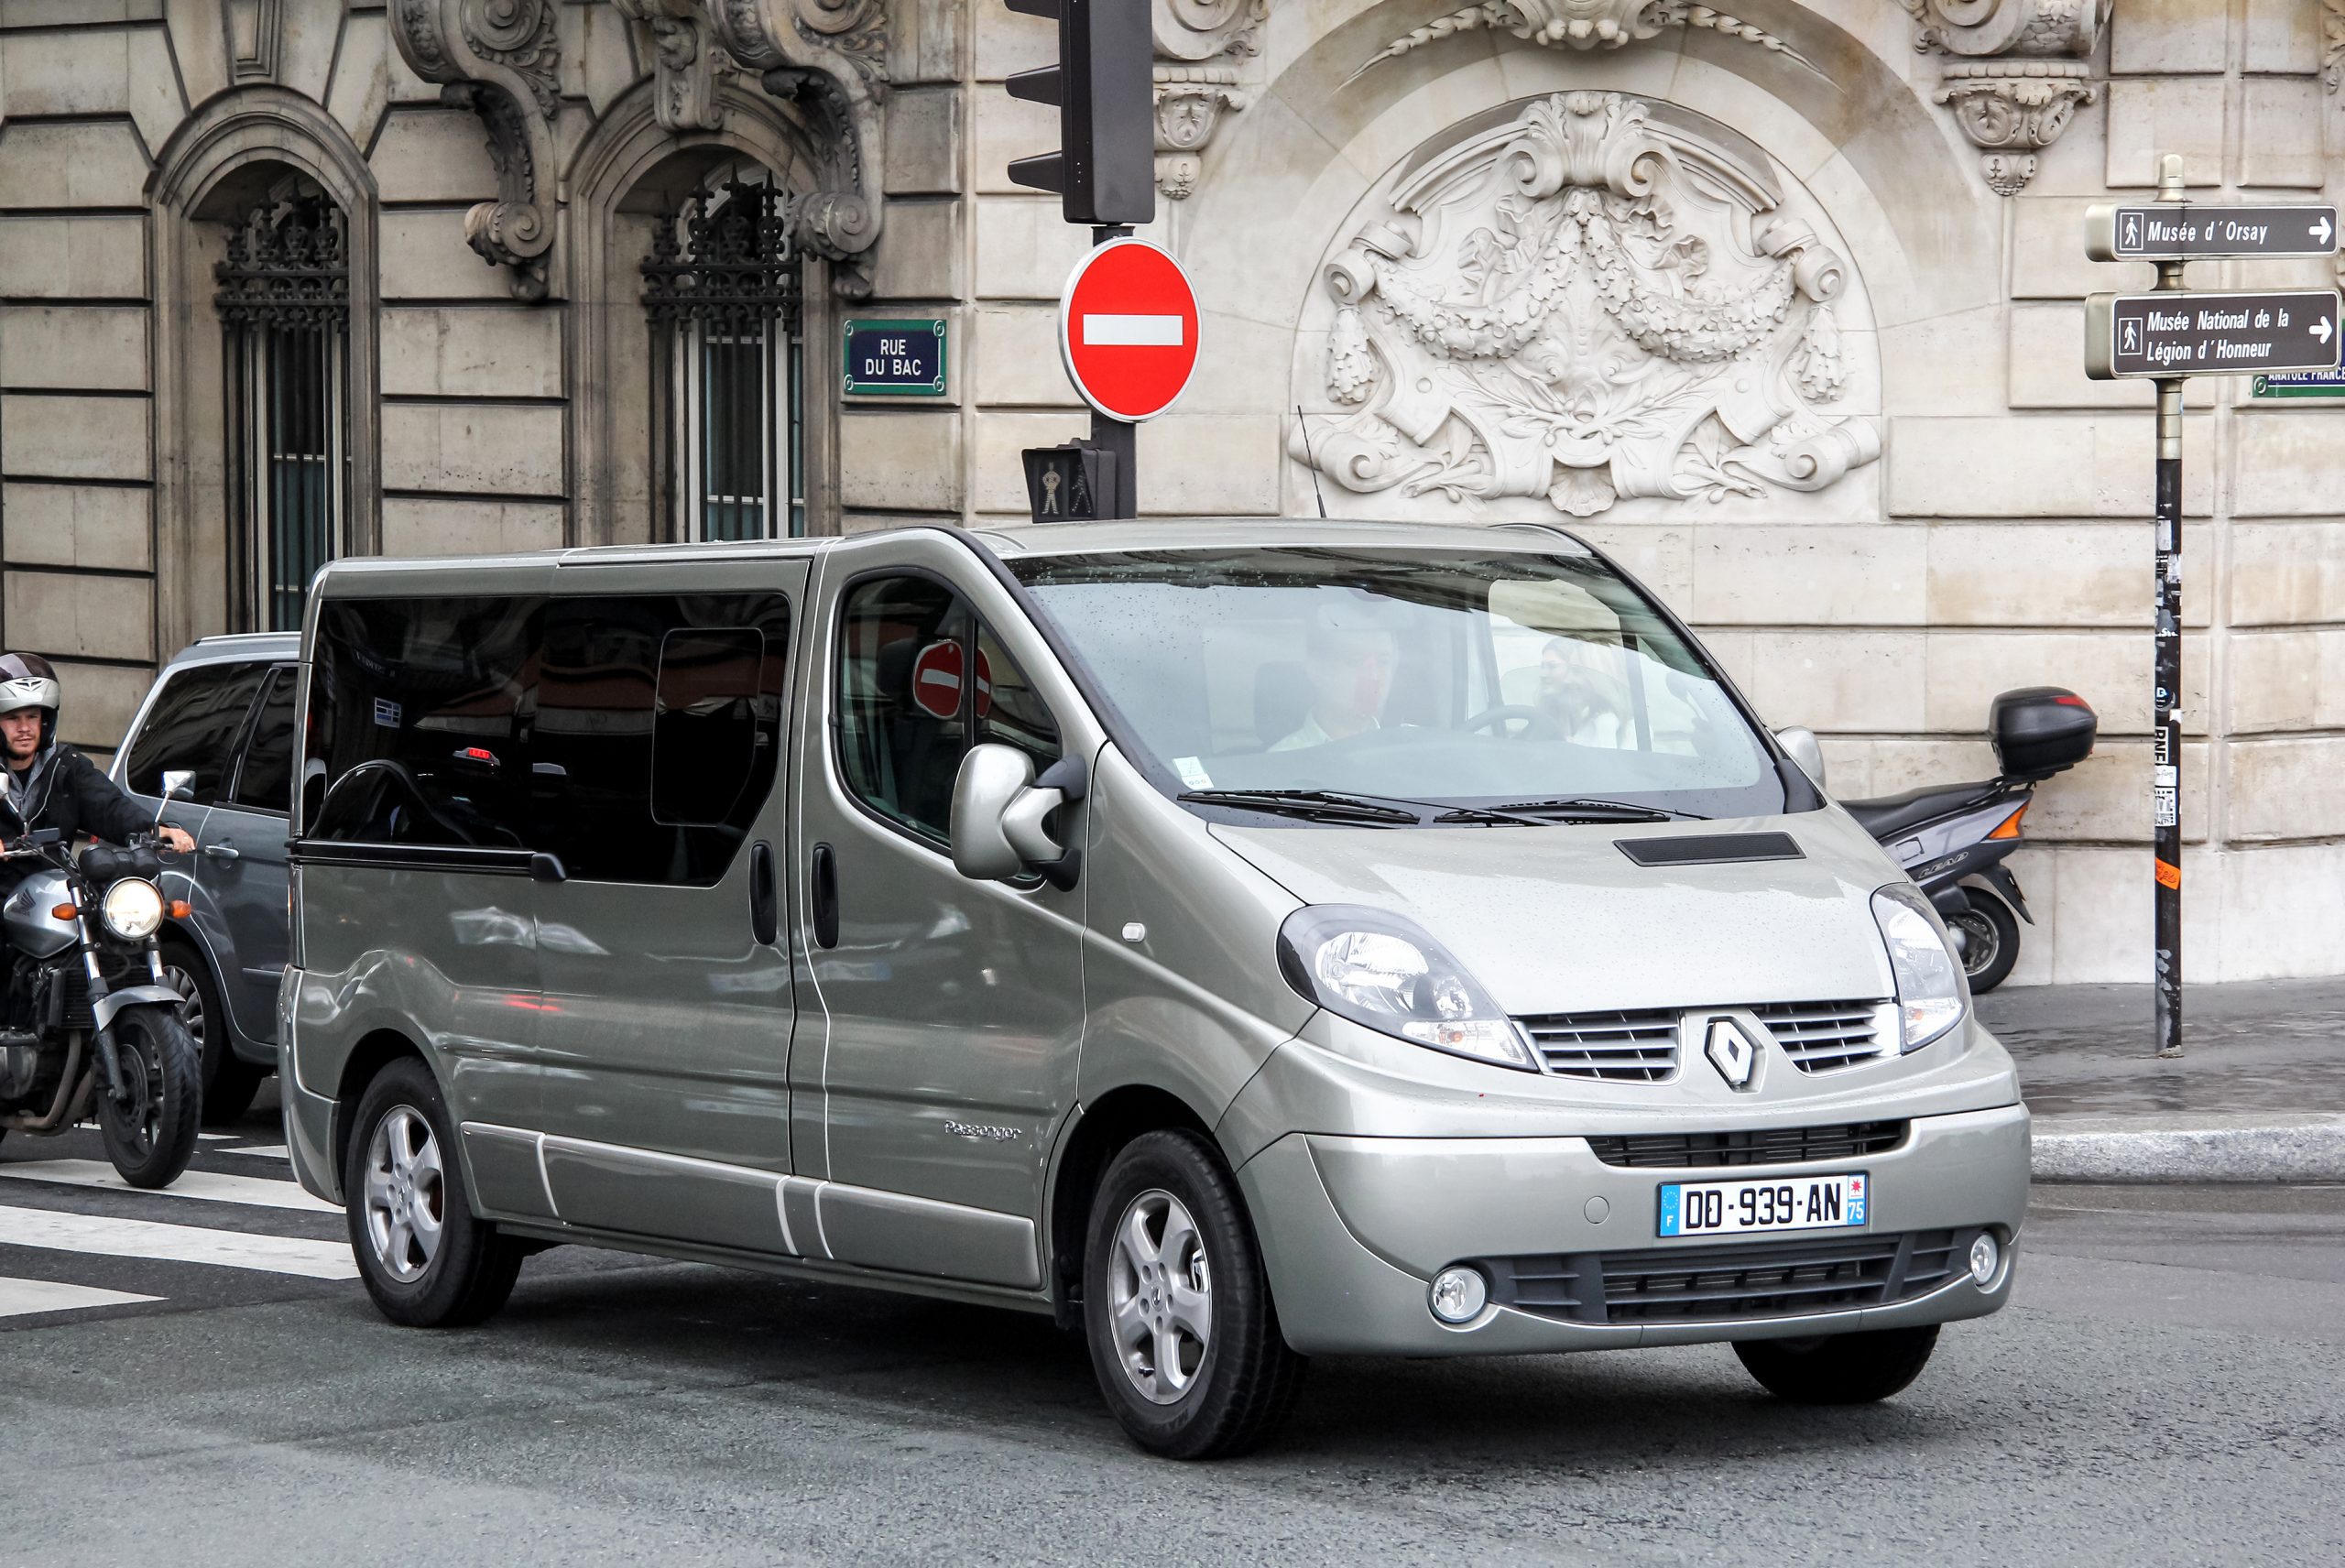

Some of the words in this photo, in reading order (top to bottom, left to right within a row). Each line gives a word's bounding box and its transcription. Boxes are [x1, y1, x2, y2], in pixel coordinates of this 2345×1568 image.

[2147, 221, 2197, 242] Musée
[2146, 310, 2190, 332] Musée
[2197, 309, 2250, 331] National
[2254, 308, 2271, 329] de
[2276, 308, 2289, 327] la
[880, 339, 907, 355] RUE
[2146, 340, 2192, 366] Légion
[865, 358, 885, 376] DU
[892, 358, 922, 376] BAC
[943, 1119, 1023, 1143] Passenger
[1685, 1182, 1841, 1229] DD-939-AN
[1848, 1201, 1864, 1220] 75
[1666, 1214, 1674, 1227] F
